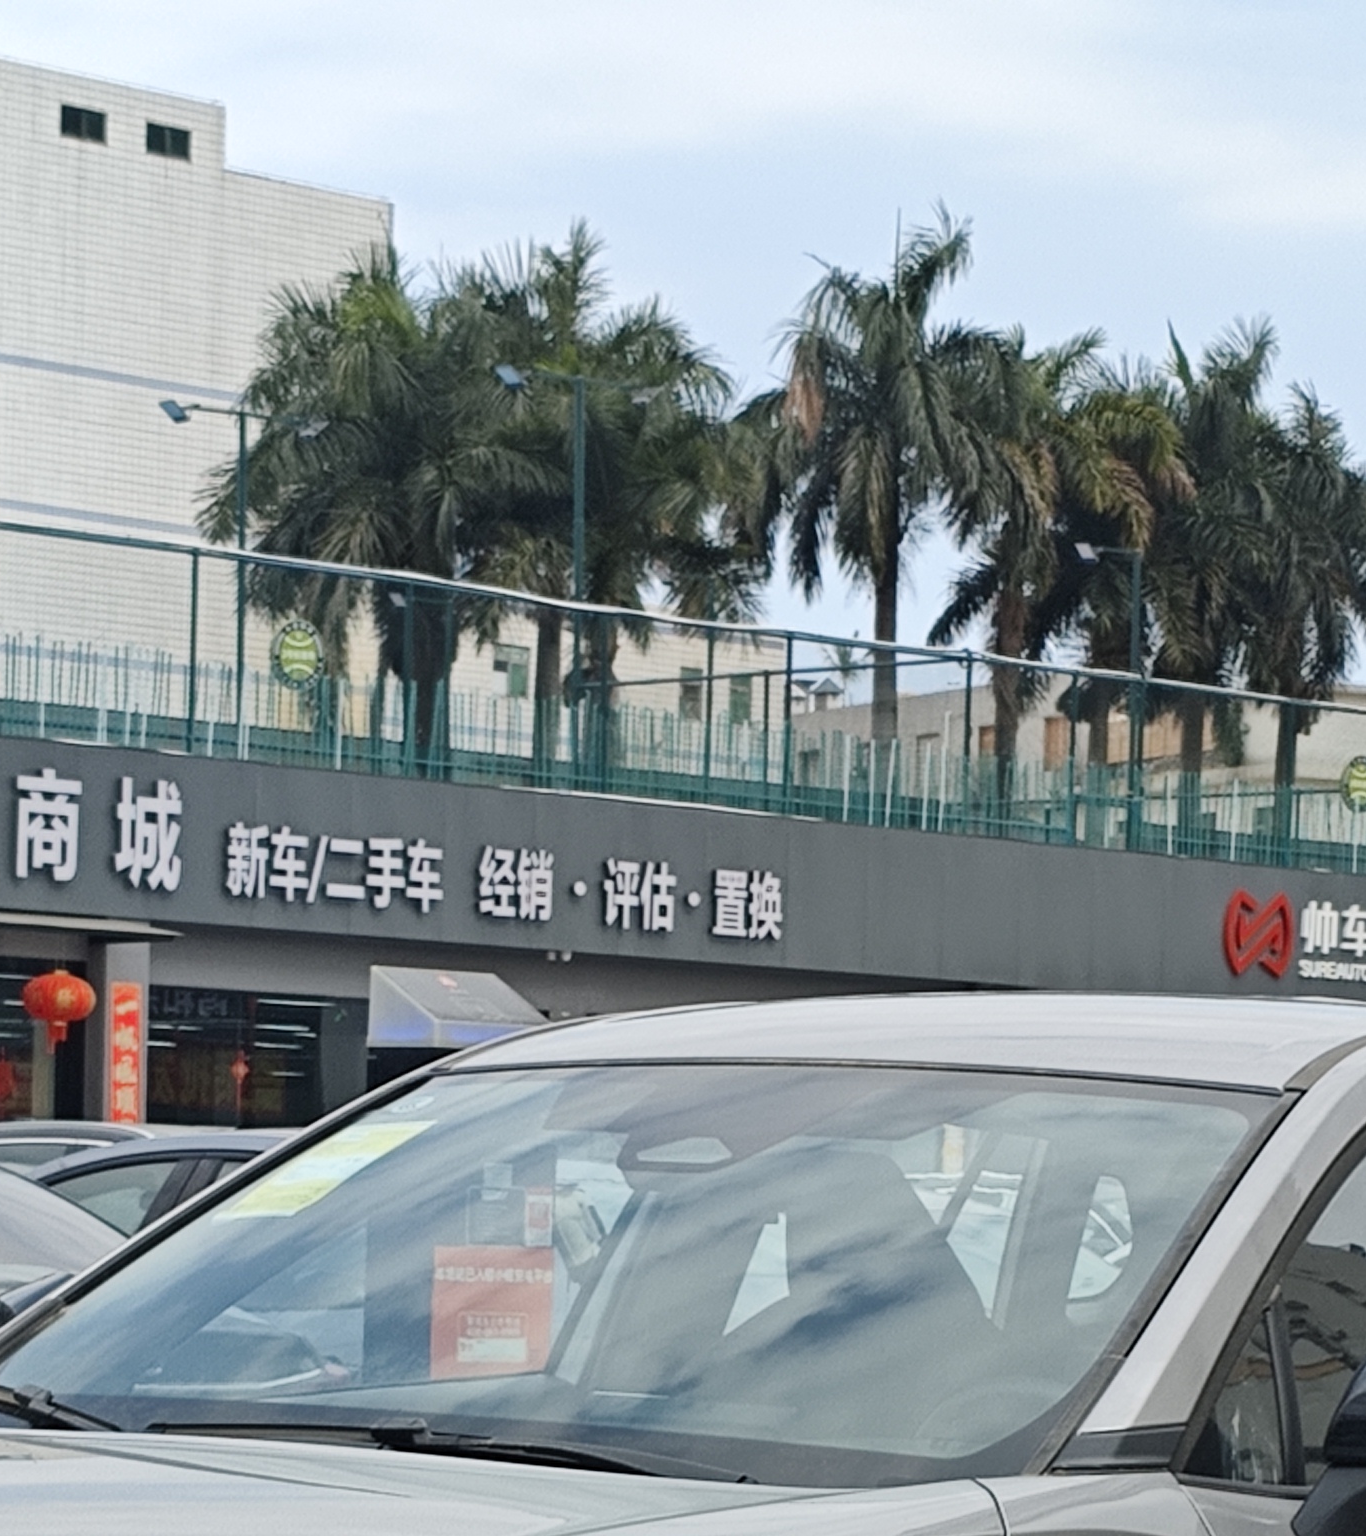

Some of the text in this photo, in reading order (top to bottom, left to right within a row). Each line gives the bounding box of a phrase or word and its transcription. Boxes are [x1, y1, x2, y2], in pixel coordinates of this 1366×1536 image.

[226, 821, 445, 913] 新车/二手车
